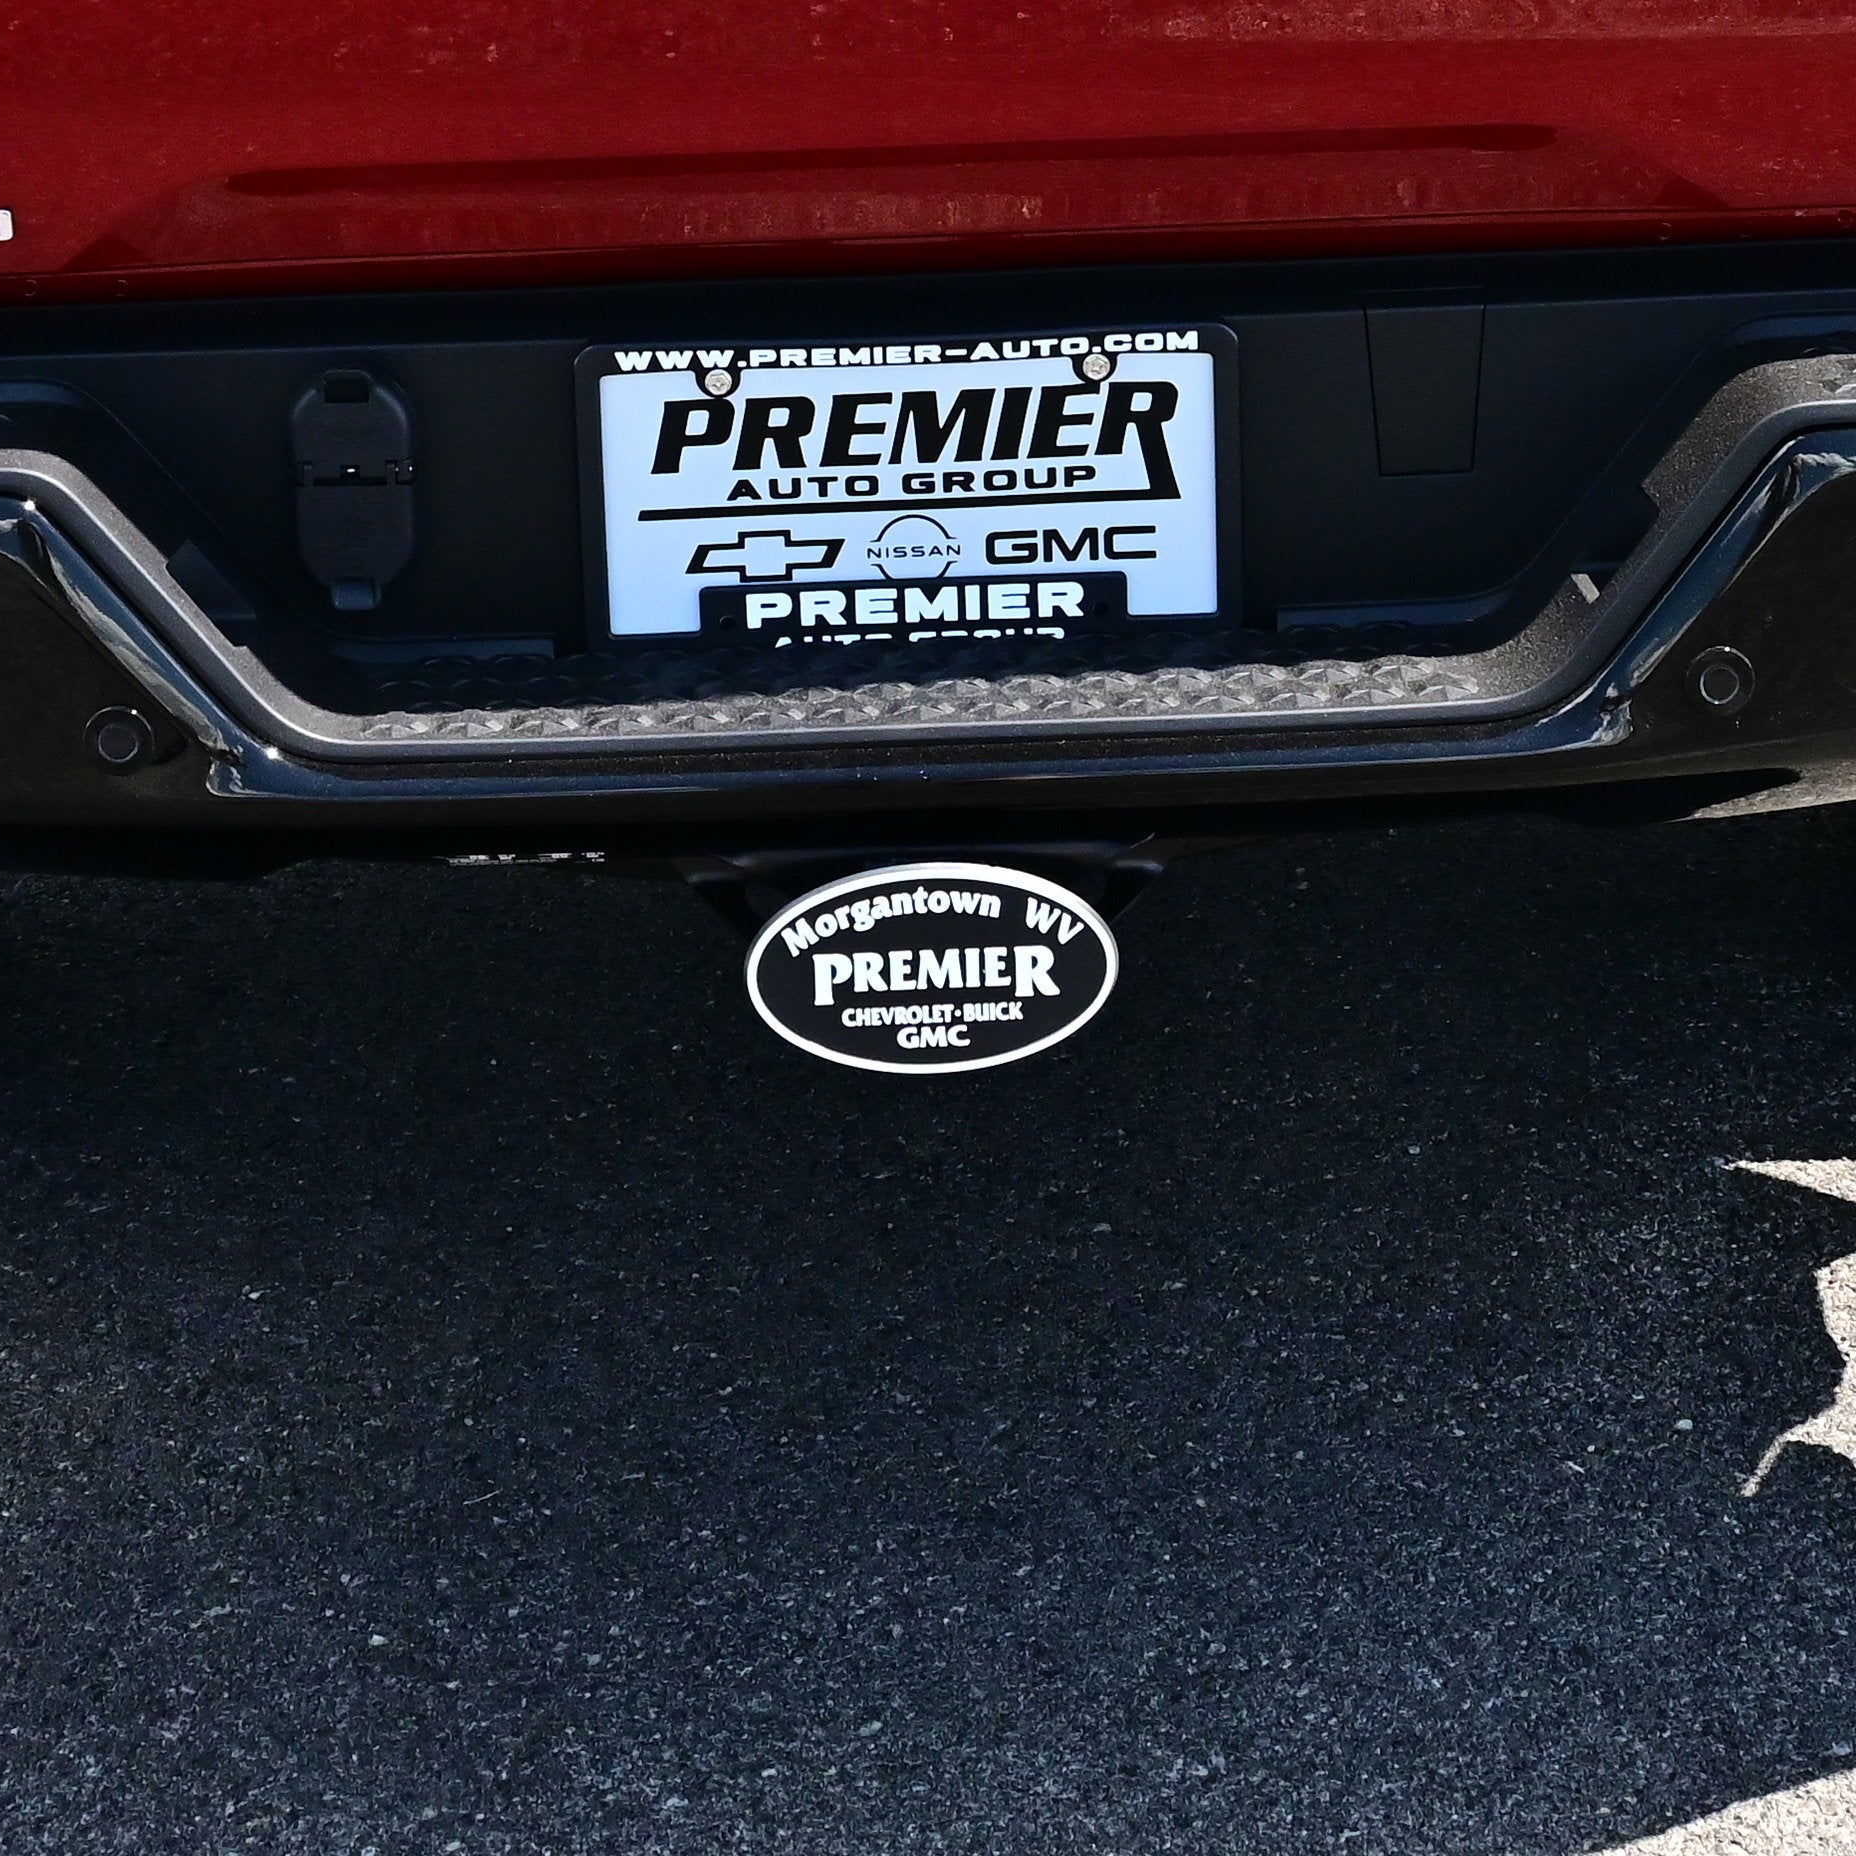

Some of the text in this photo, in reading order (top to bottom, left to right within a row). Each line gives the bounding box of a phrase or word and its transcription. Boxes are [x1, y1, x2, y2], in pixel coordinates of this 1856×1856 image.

[614, 330, 1199, 371] WWW.PREMIER-AUTO.COM
[650, 380, 1180, 478] PREMIER
[726, 465, 1096, 502] AUTO GROUP
[867, 525, 1157, 565] NISSAN GMC
[746, 581, 1084, 629] PREMIER
[780, 885, 1085, 958] Morgantown WV
[812, 945, 1061, 1006] PREMIER
[896, 1025, 971, 1049] GMC
